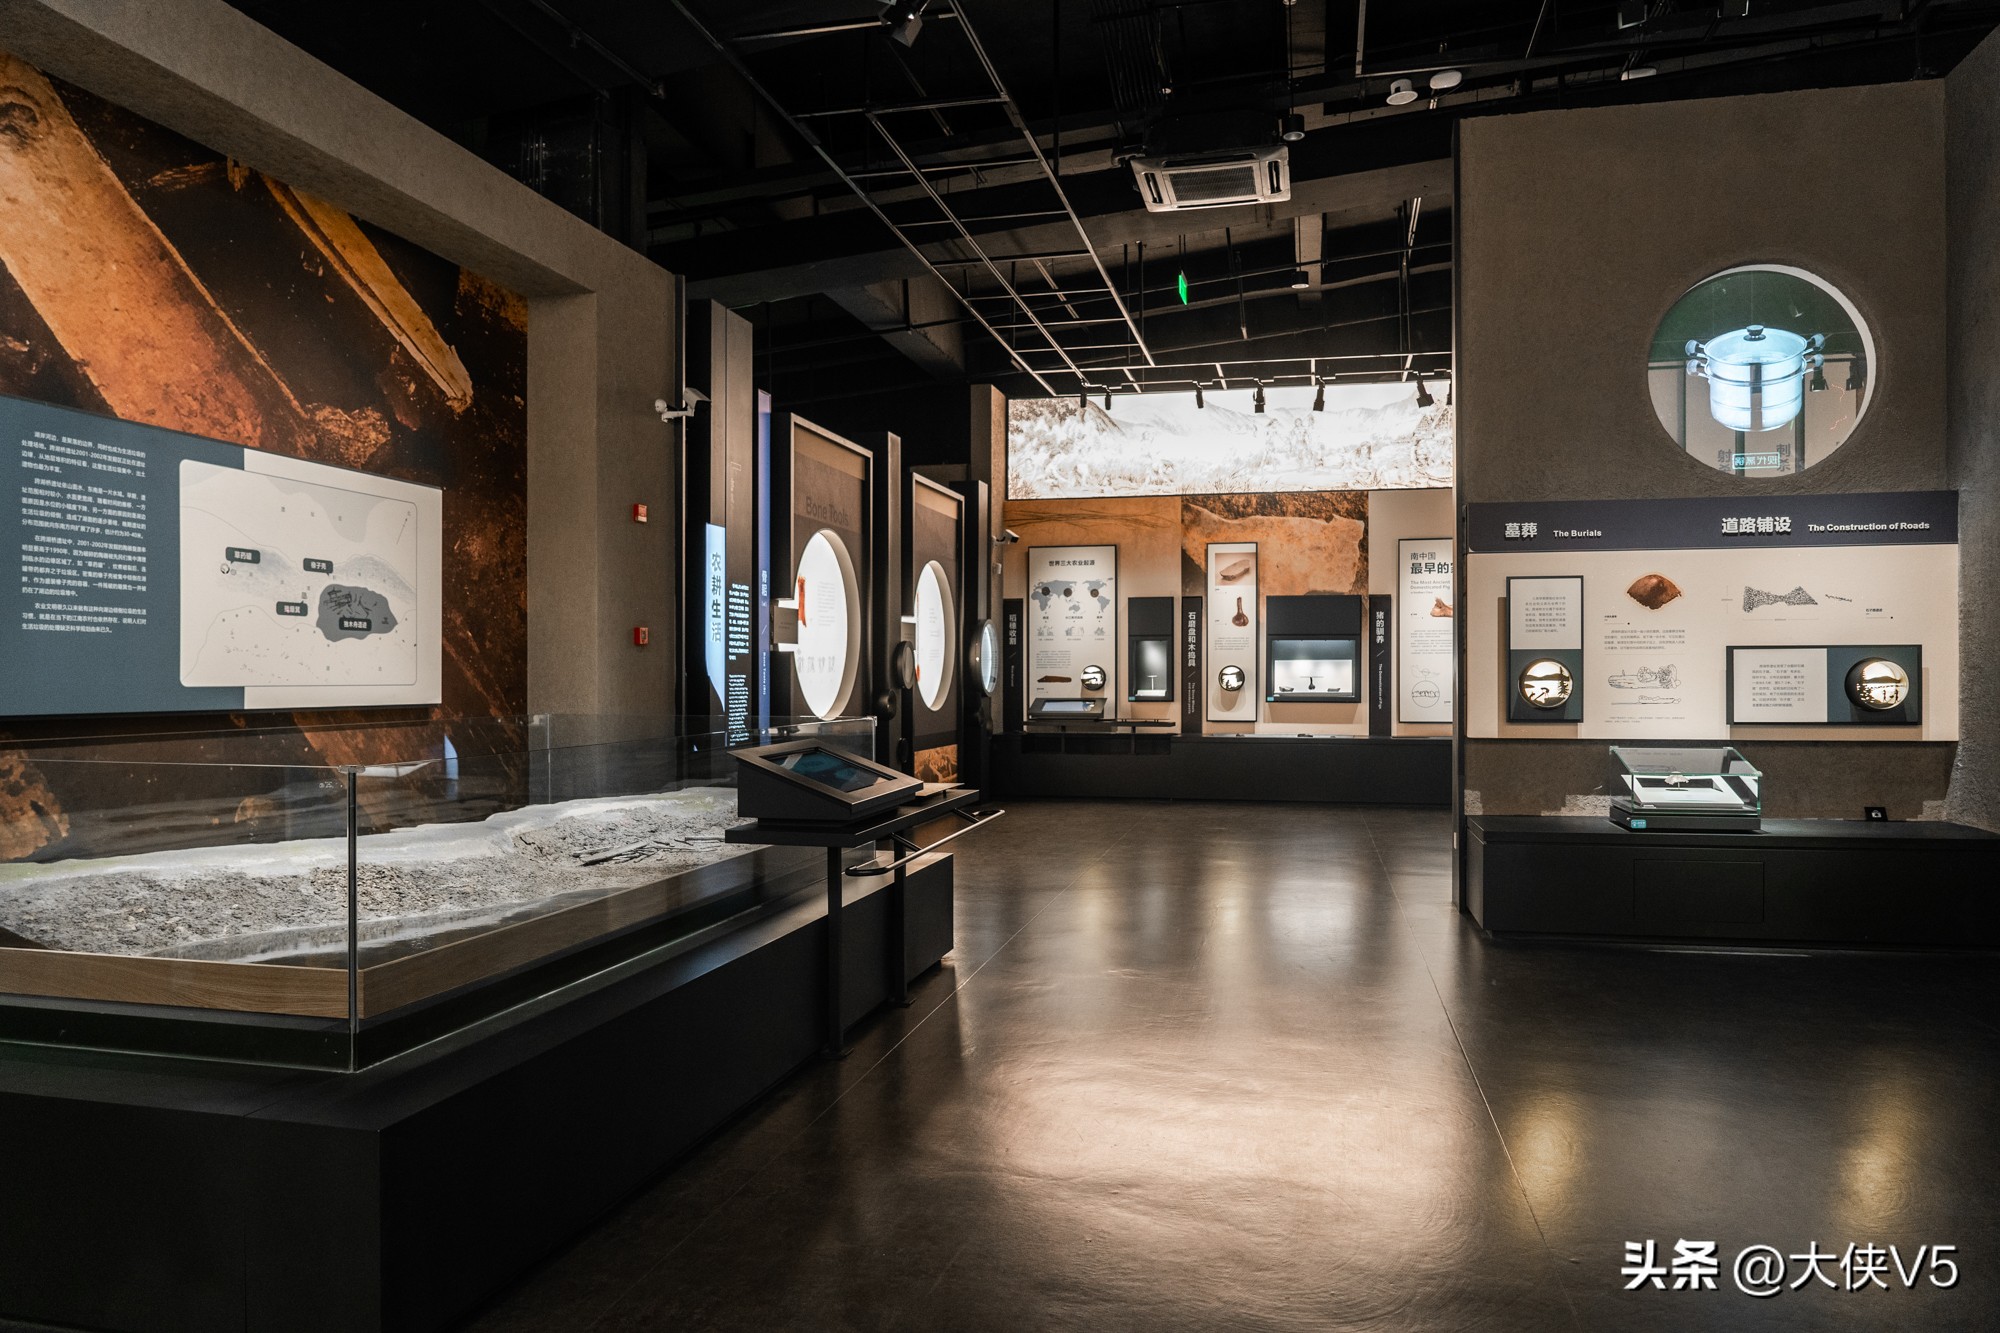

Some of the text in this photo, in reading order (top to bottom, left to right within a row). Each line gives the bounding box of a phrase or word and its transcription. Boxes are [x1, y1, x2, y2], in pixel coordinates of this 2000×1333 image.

[806, 496, 849, 526] Bone Tools
[1504, 522, 1538, 539] 墓葬
[1721, 516, 1792, 534] 道路铺设
[1808, 521, 1930, 532] The Construction of Roads
[1553, 529, 1602, 538] The Burials
[1410, 552, 1436, 560] 南中国
[1410, 562, 1454, 574] 最早的
[712, 552, 722, 642] 农耕生活
